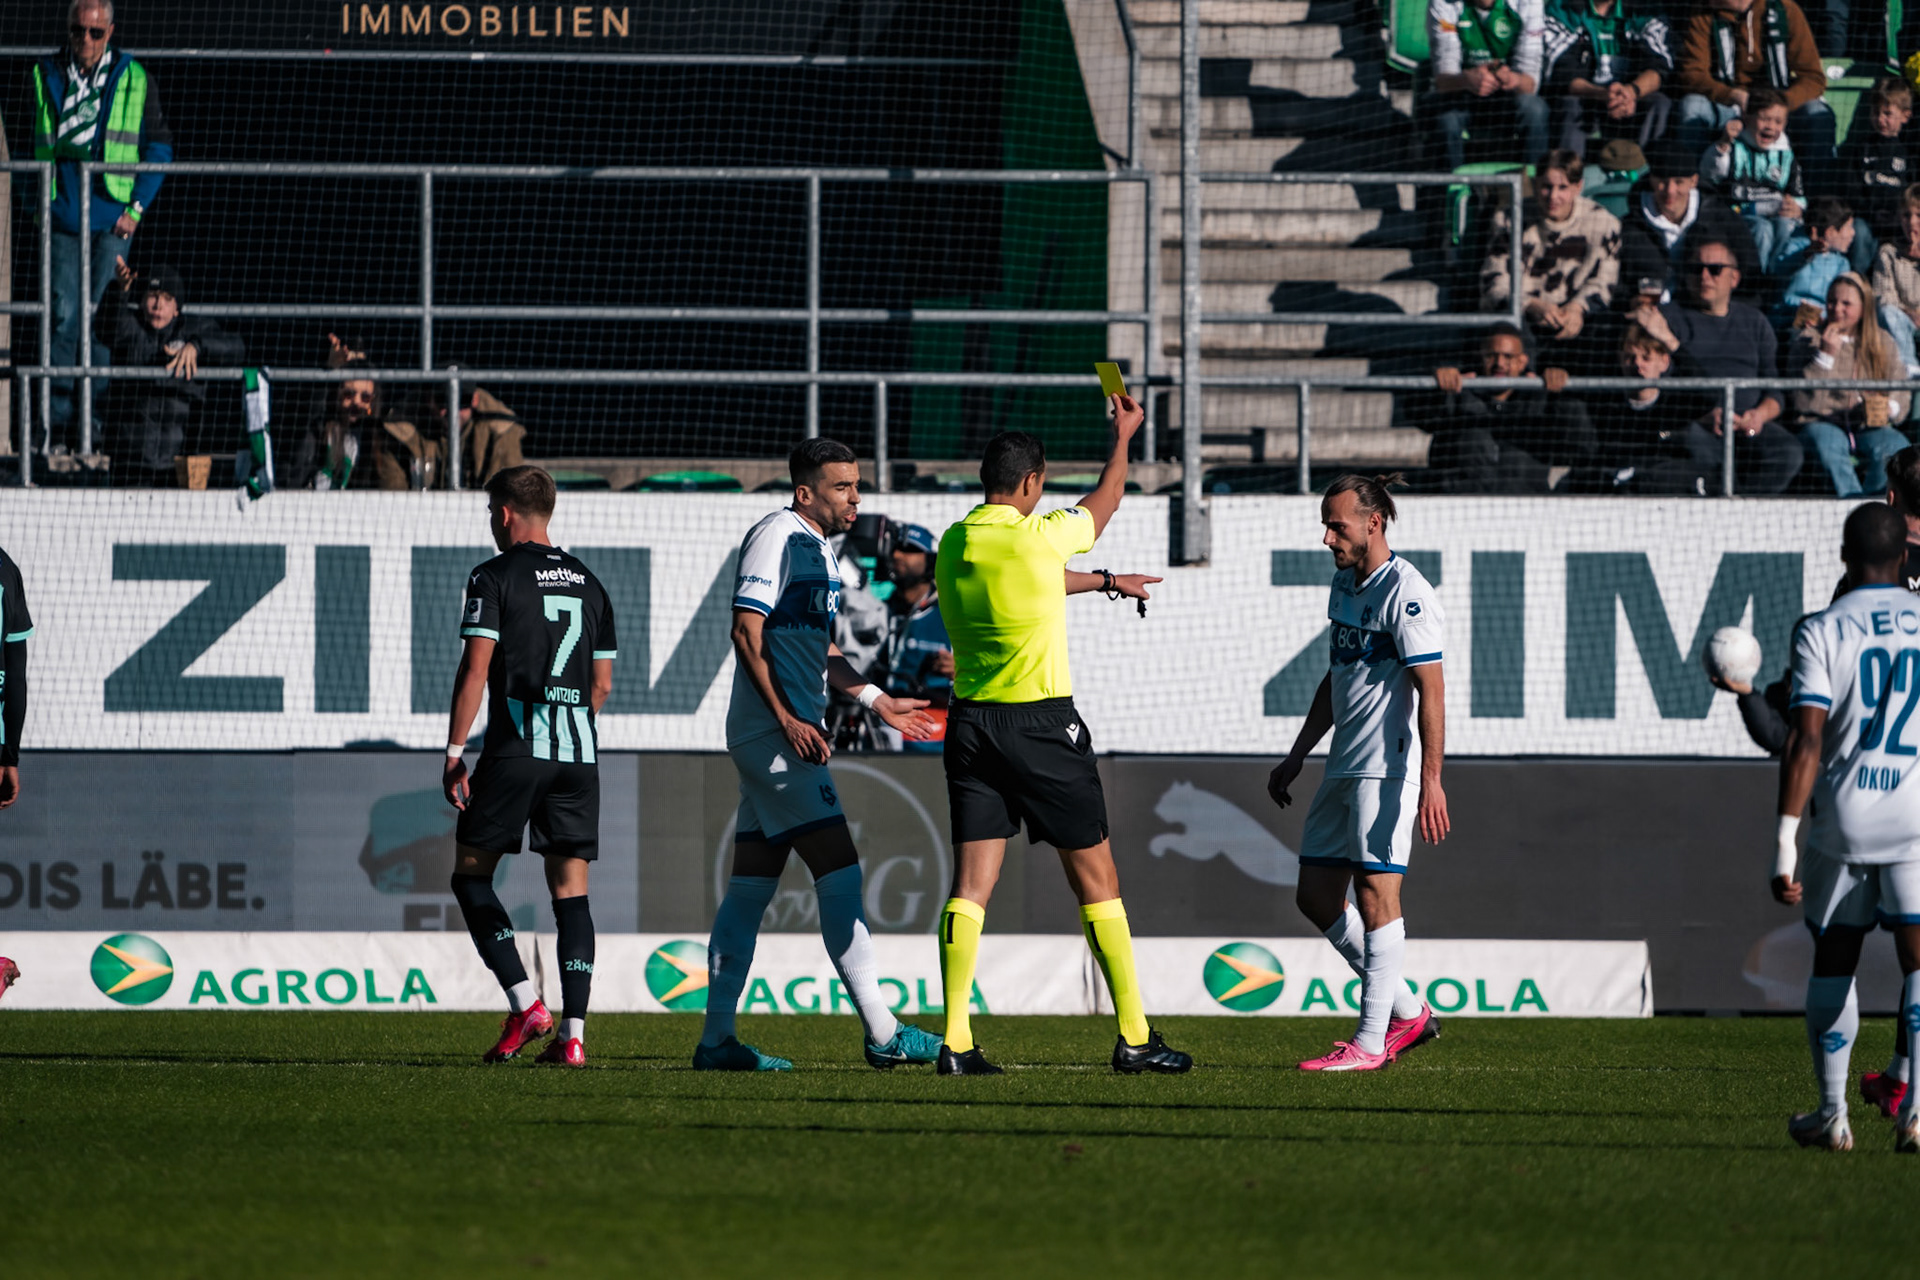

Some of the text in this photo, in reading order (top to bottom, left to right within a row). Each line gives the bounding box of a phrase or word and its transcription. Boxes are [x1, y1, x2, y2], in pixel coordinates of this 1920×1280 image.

[342, 3, 630, 38] IMMOBILIEN
[534, 566, 586, 585] Mettler
[543, 594, 583, 677] 7
[544, 685, 581, 704] WITZIG
[1859, 647, 1920, 756] 92
[101, 850, 266, 911] LÄBE.
[189, 968, 439, 1005] AGROLA
[1299, 977, 1550, 1013] AOLA
